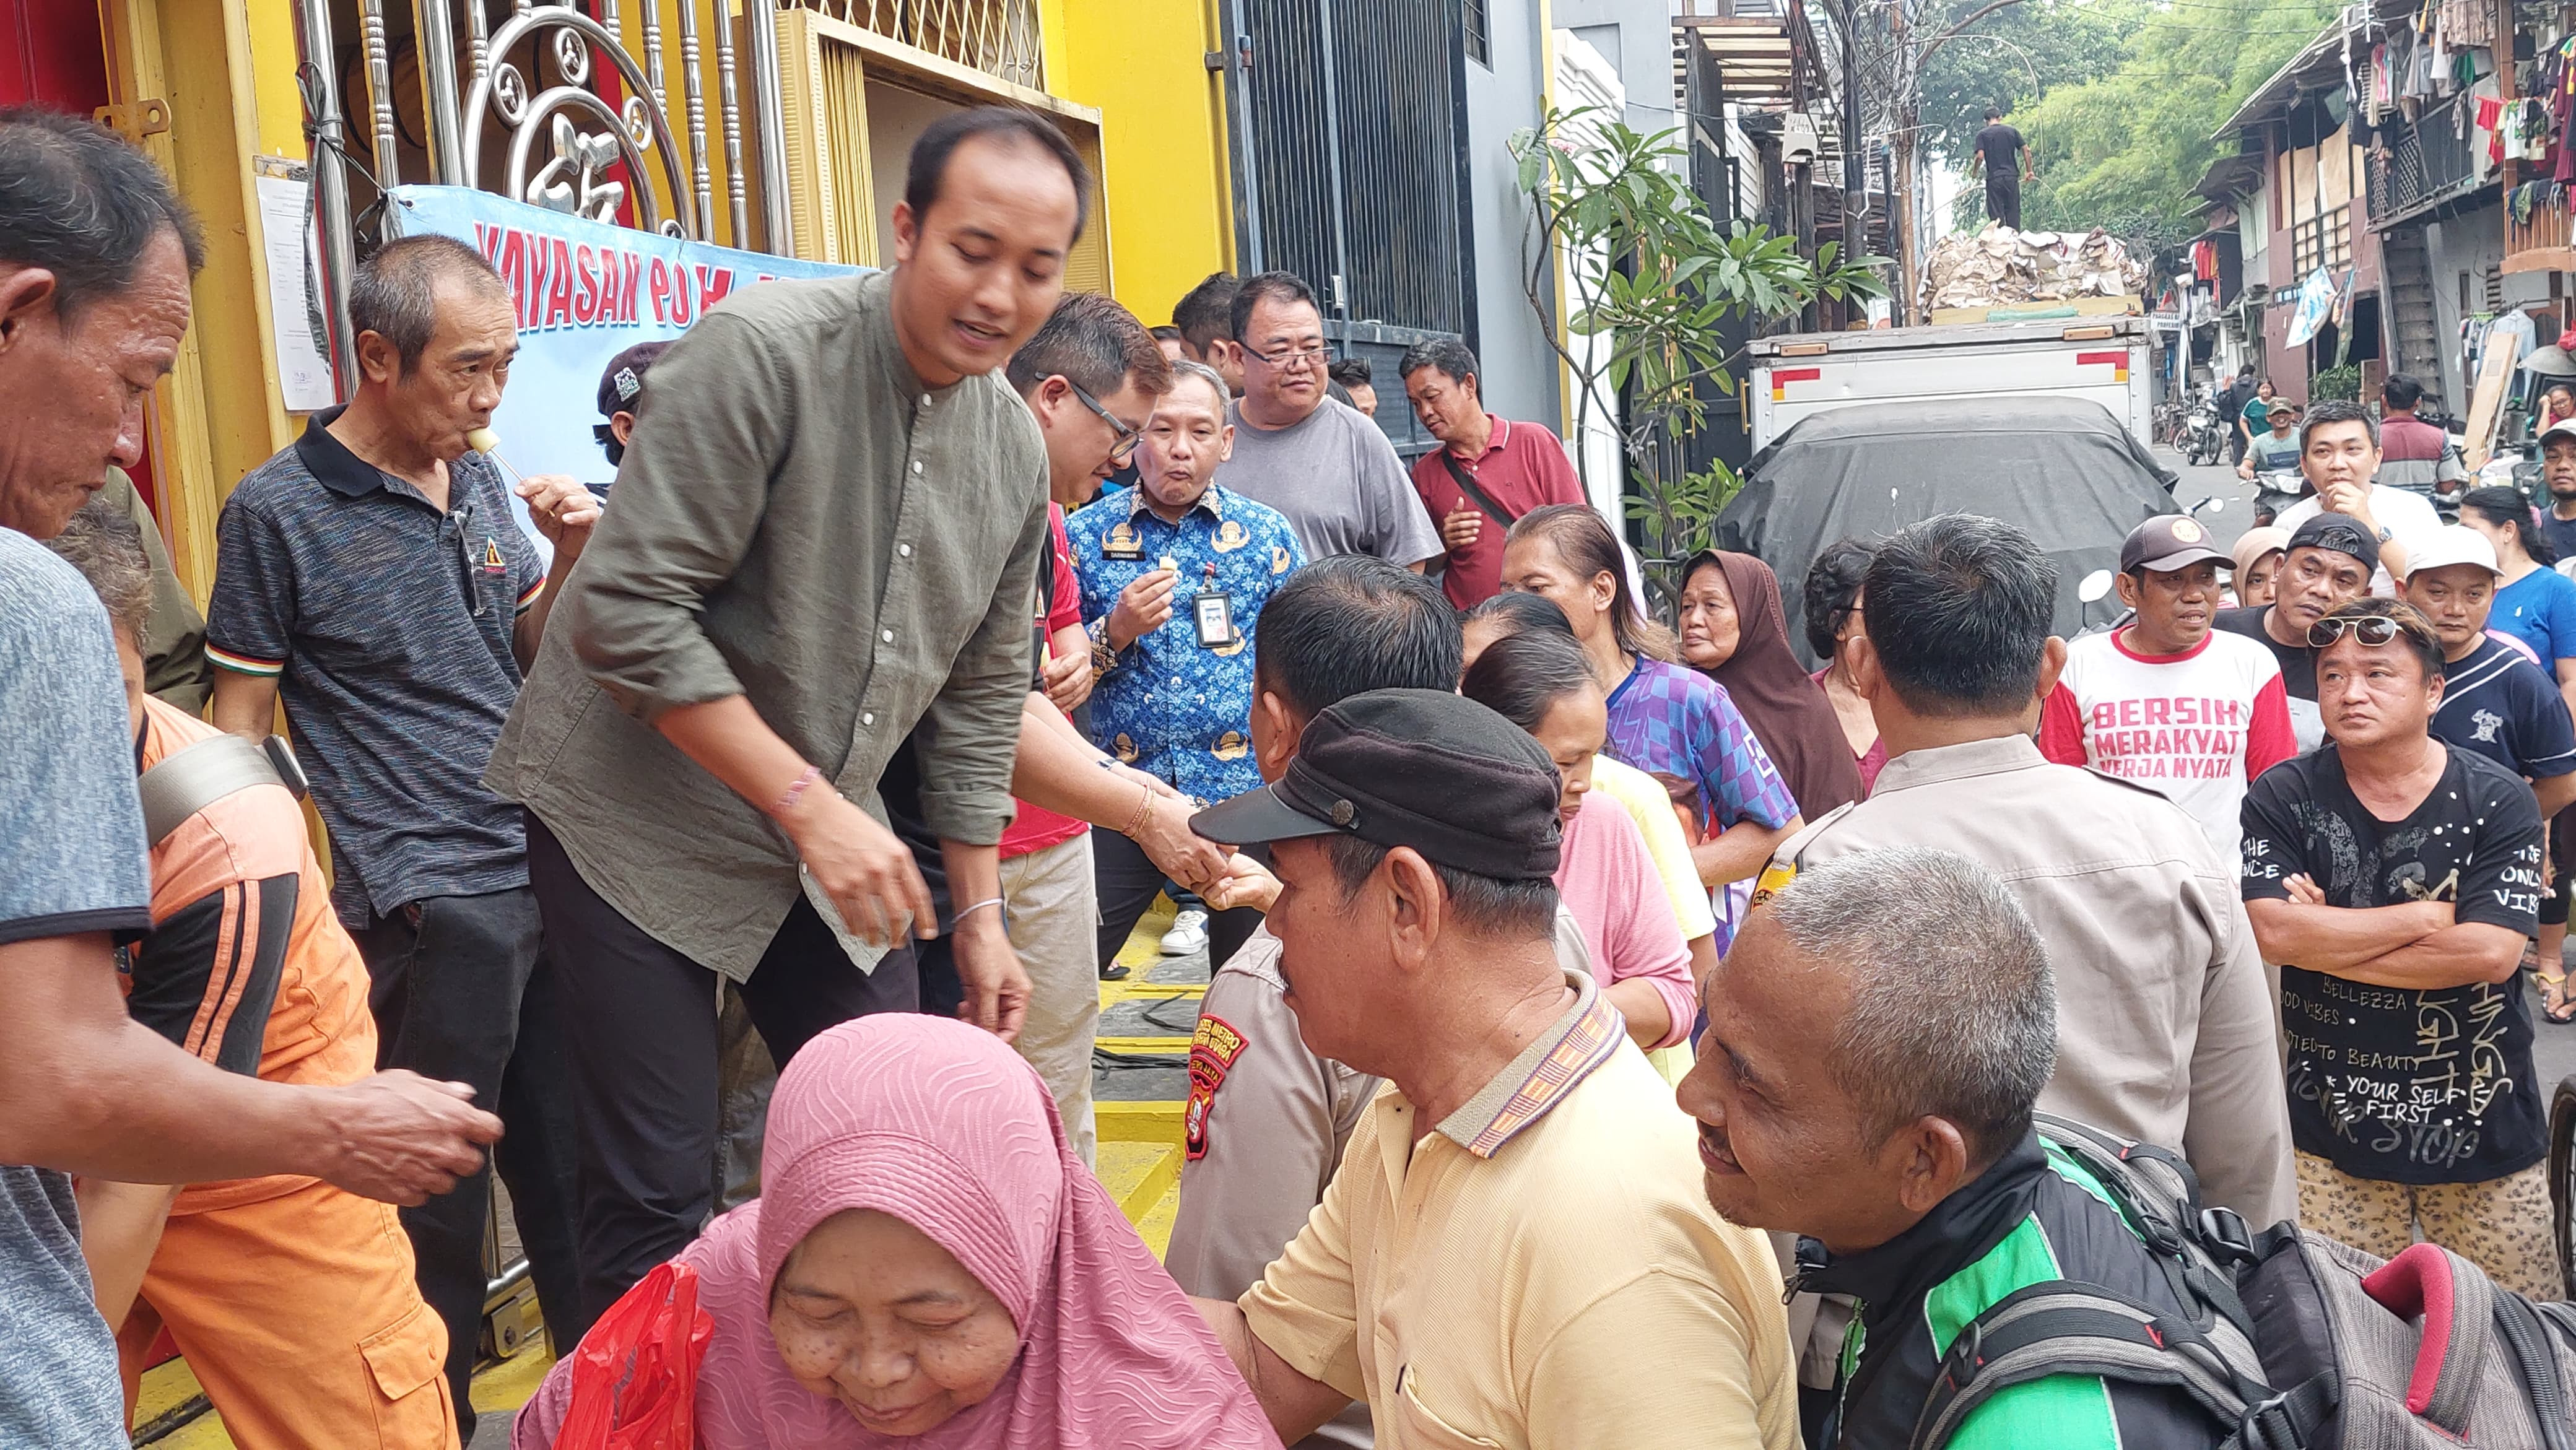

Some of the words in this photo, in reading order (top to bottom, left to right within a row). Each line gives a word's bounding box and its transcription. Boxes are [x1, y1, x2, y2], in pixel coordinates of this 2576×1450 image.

[2092, 697, 2239, 730] BERSIH
[2094, 729, 2240, 758] MERAKYAT
[2172, 757, 2232, 779] NYATA
[2492, 888, 2539, 914] VIB
[2323, 976, 2407, 1011] BELLEZZA
[2303, 999, 2339, 1025] VIBES
[2346, 1074, 2401, 1103] YOUR
[2408, 1085, 2461, 1106] SELF
[2366, 1100, 2436, 1125] FIRST
